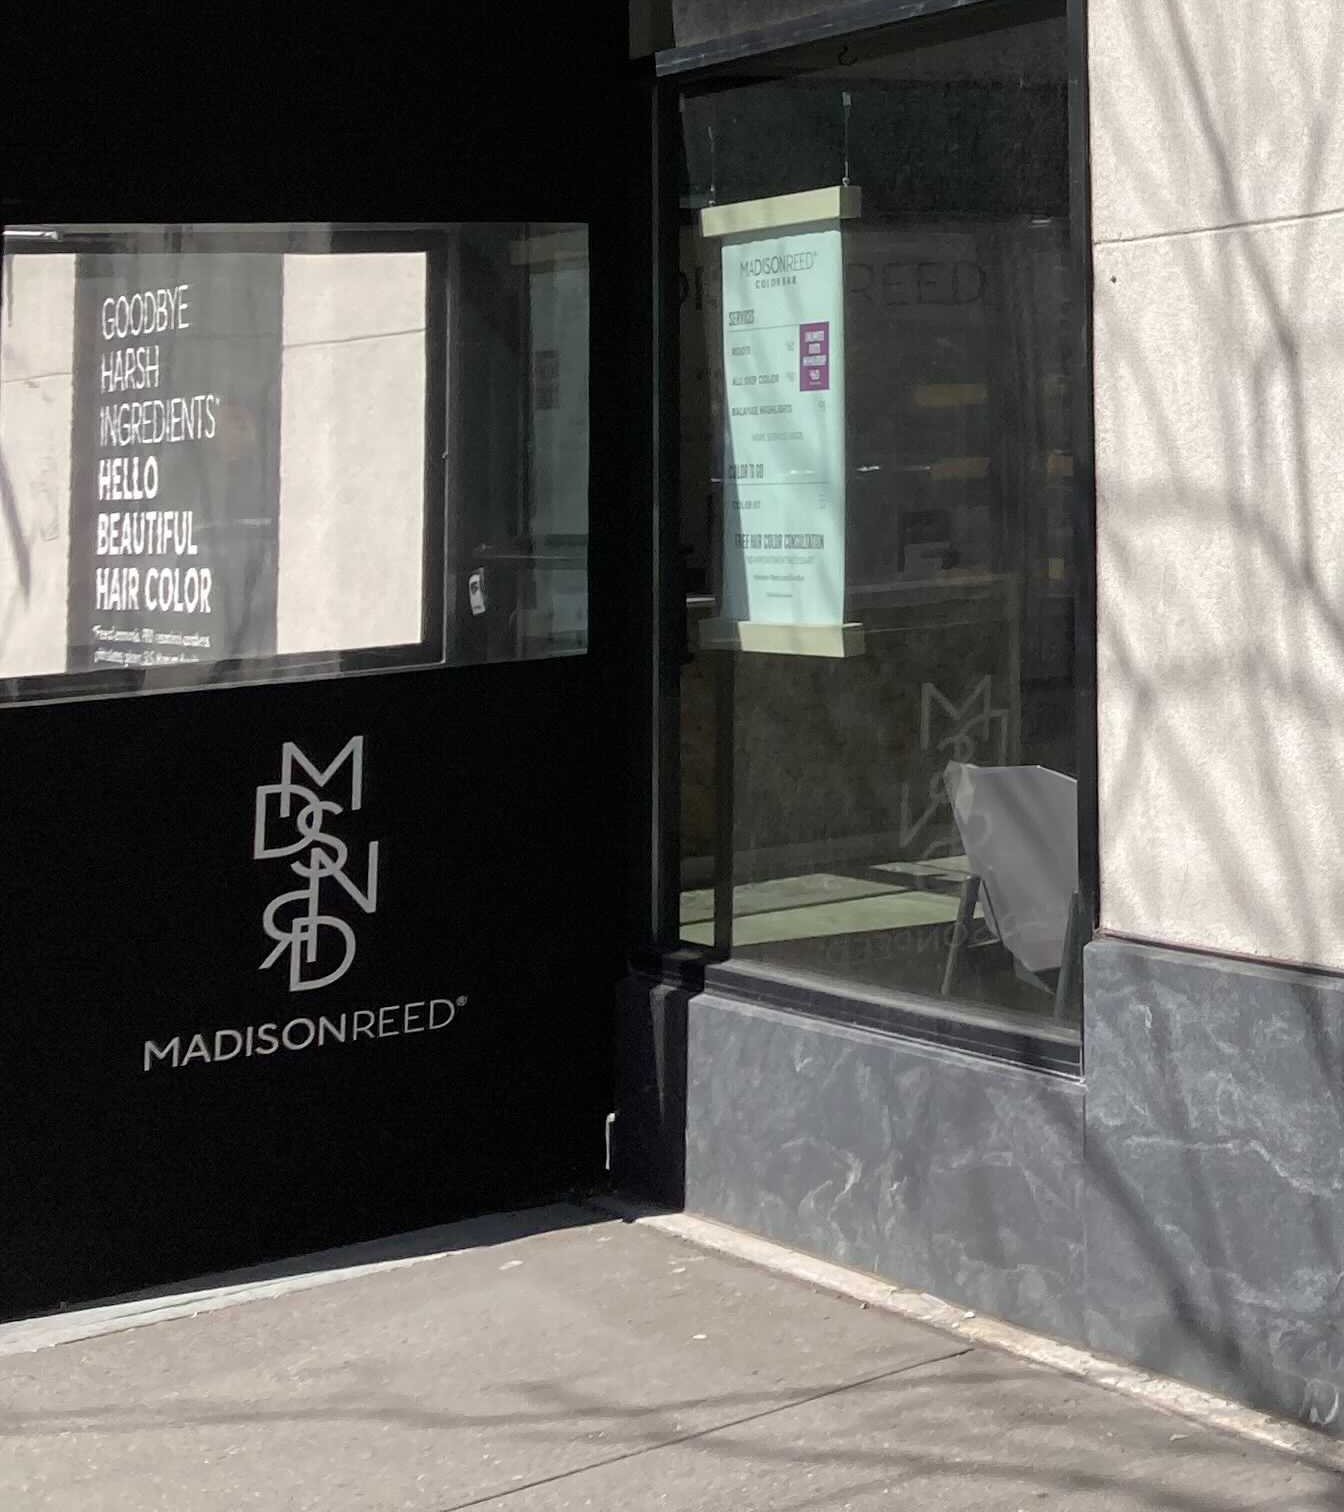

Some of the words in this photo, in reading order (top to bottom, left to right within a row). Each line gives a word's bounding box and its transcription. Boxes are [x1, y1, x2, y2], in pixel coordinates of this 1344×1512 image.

[102, 285, 190, 340] GOODBYE
[101, 345, 160, 393] HARSH
[98, 455, 159, 501] HELLO
[96, 511, 198, 556] BEAUTIFUL
[95, 567, 140, 611] HAIR
[144, 567, 212, 613] COLOR
